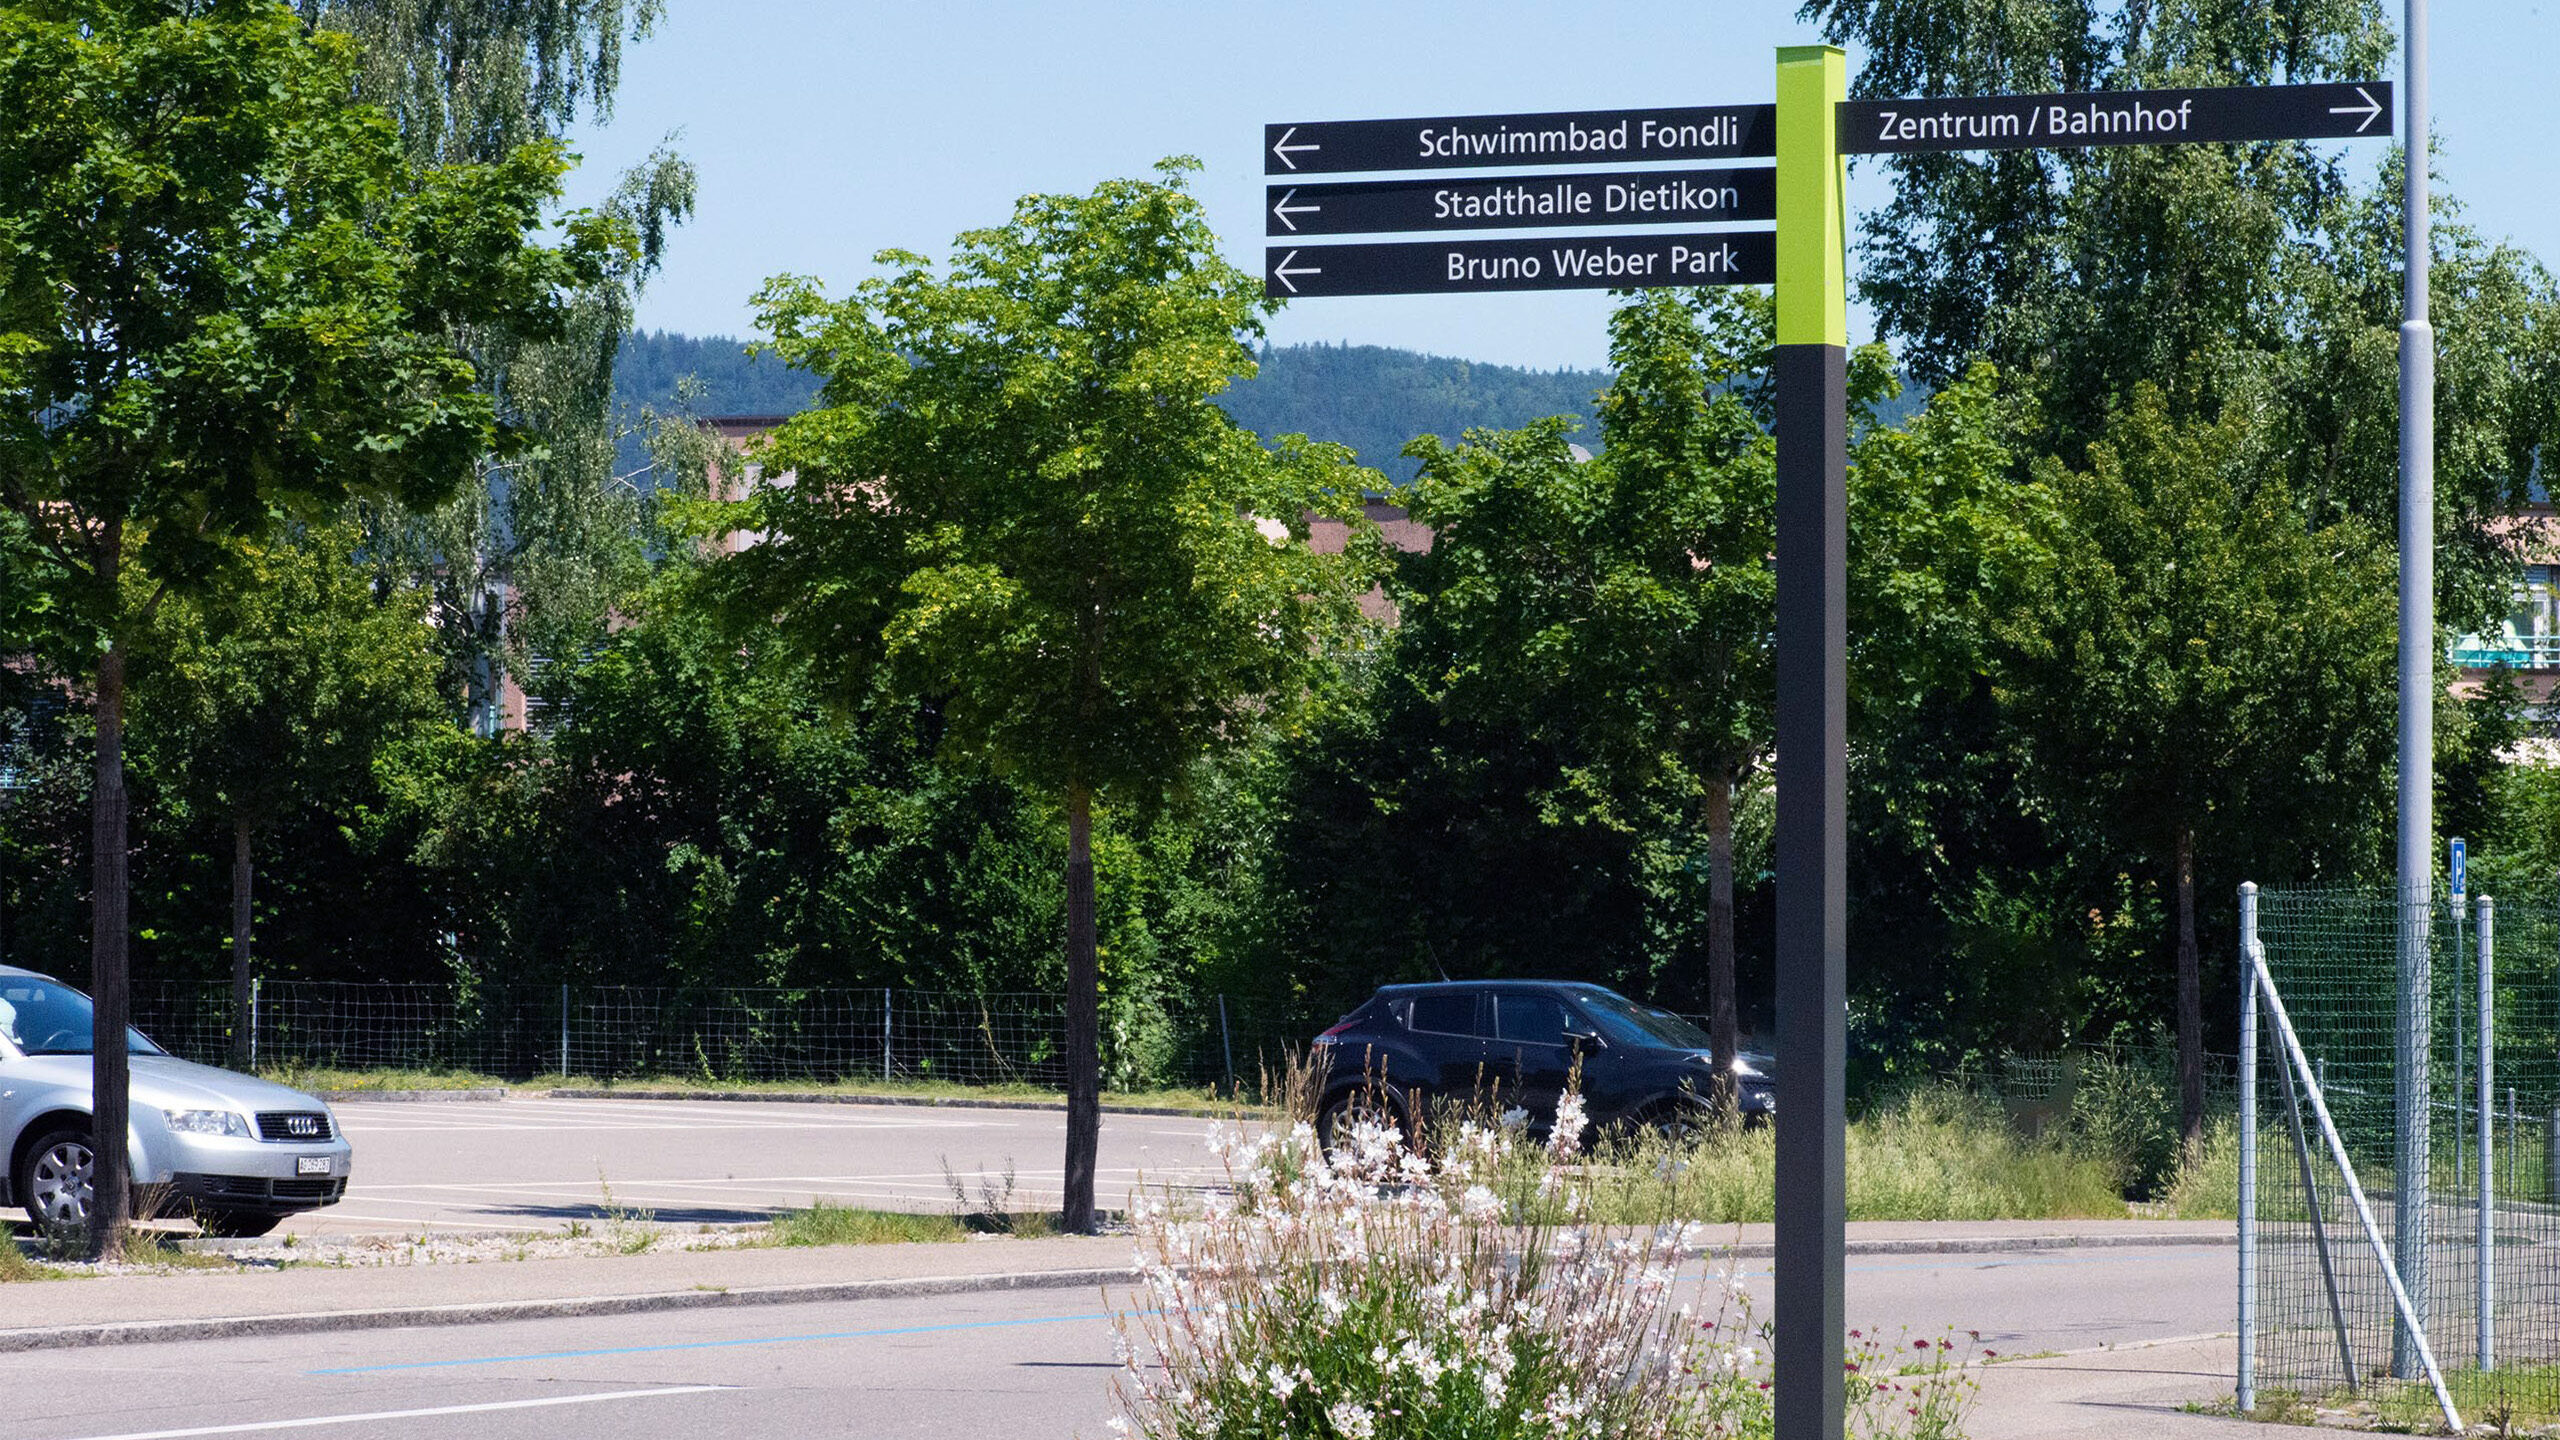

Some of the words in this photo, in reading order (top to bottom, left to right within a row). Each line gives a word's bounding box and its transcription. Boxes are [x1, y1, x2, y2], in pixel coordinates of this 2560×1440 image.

[1419, 120, 1627, 157] Schwimmbad
[1641, 115, 1738, 149] Fondli
[1879, 111, 2019, 141] Zentrum
[2049, 98, 2193, 135] Bahnhof
[1434, 183, 1592, 219] Stadthalle
[1605, 180, 1738, 213] Dietikon
[1447, 252, 1541, 281] Bruno
[1551, 245, 1659, 277] Weber
[1671, 242, 1739, 274] Park
